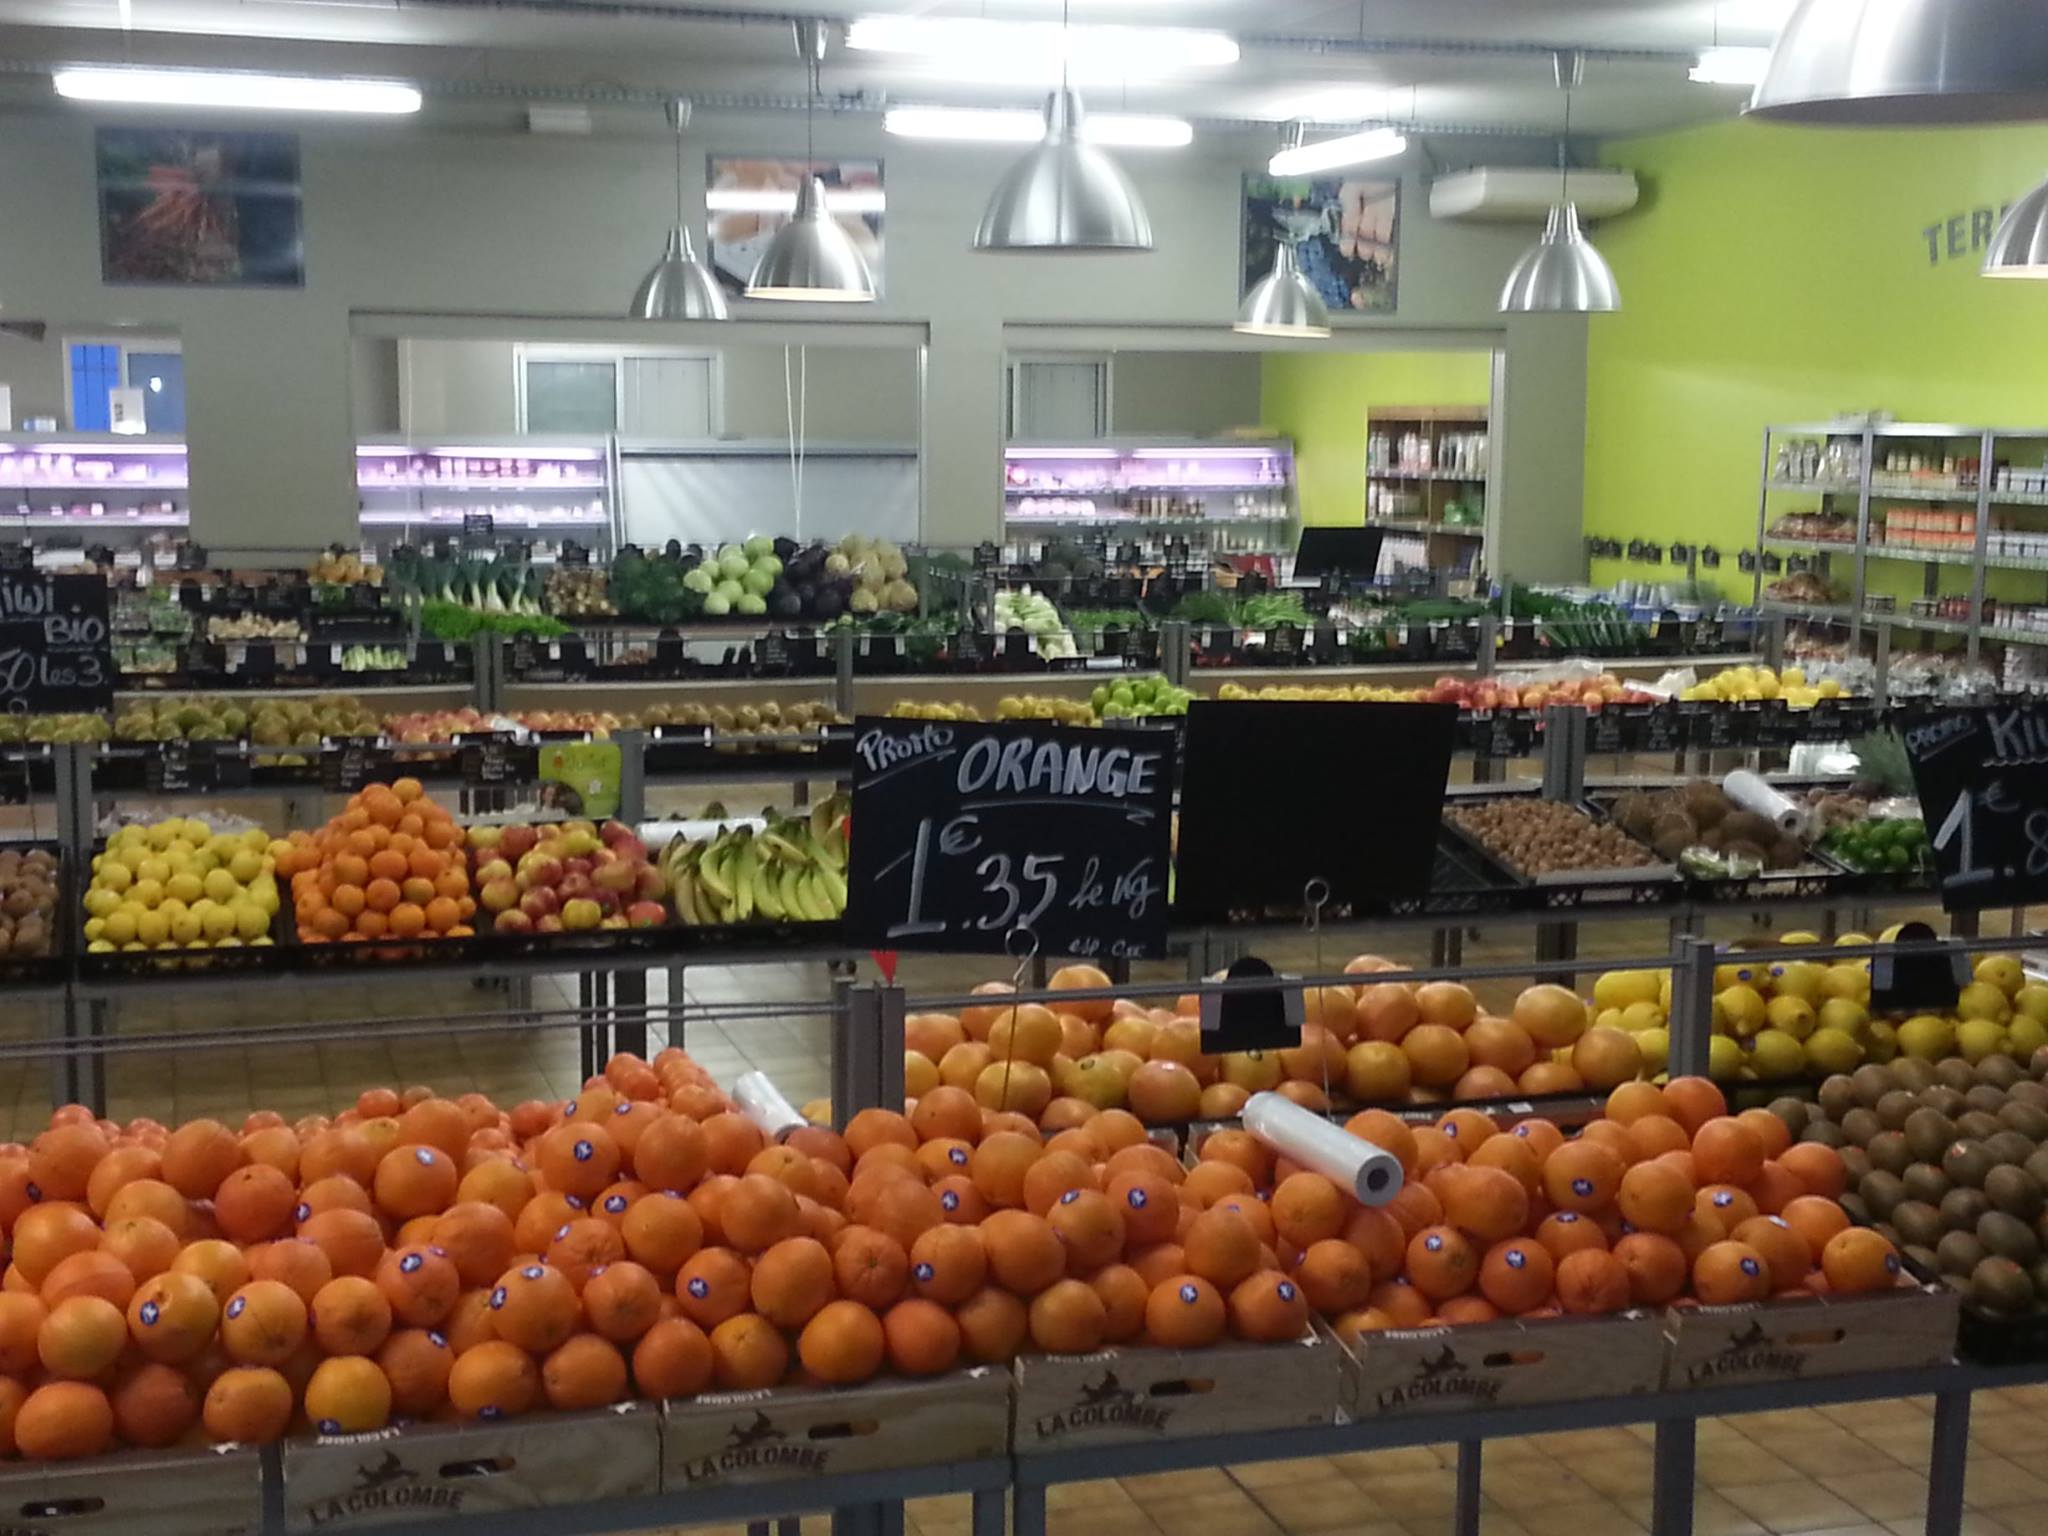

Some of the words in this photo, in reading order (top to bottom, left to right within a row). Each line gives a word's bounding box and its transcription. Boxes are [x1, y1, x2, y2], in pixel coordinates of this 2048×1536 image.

[1923, 206, 2009, 267] TER
[957, 737, 1161, 797] ORANGE
[1068, 855, 1103, 910] le
[1036, 1414, 1067, 1438] LA
[1069, 1402, 1175, 1430] COLOMBE
[684, 1455, 717, 1482] LA
[720, 1446, 829, 1471] COLOMBE
[308, 1499, 345, 1526] LA
[349, 1486, 465, 1512] COLOMBE
